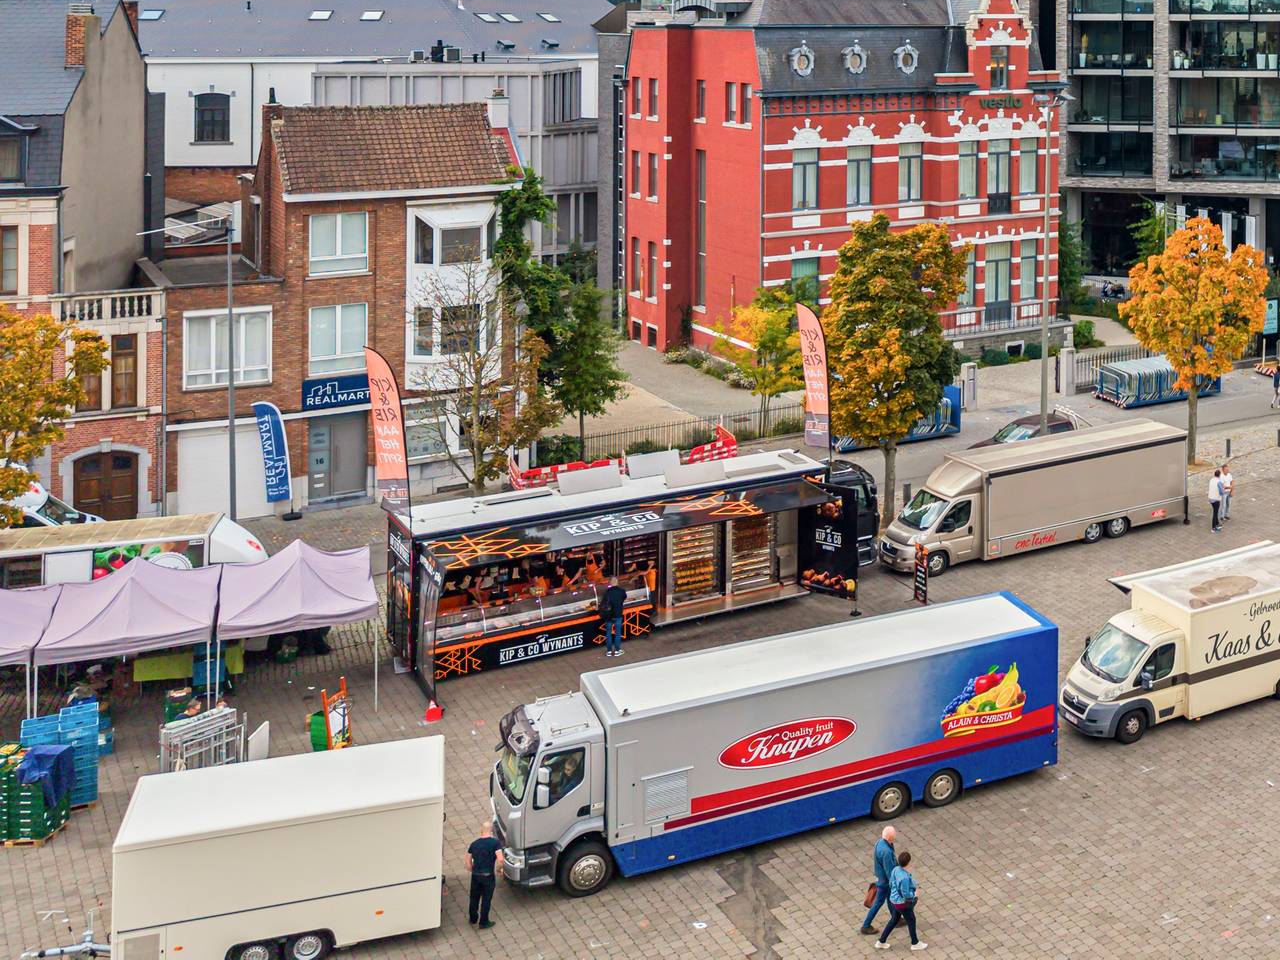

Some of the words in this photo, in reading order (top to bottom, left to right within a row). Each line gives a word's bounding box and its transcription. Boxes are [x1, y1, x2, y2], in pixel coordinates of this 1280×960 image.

[306, 390, 371, 406] REALMART
[566, 522, 600, 535] KIP
[609, 519, 628, 527] &
[632, 512, 660, 523] CO
[600, 524, 645, 536] WYNANTS
[815, 531, 825, 541] KIP
[827, 533, 832, 543] &
[833, 534, 842, 544] CO
[500, 650, 515, 662] KIP
[517, 648, 525, 658] &
[528, 644, 539, 655] CO
[542, 635, 583, 652] WYNANTS
[1205, 630, 1251, 664] Kaas
[1255, 619, 1274, 651] &
[947, 717, 972, 730] ALAIN
[973, 716, 980, 725] &
[980, 711, 1013, 724] CHRISTA
[781, 726, 814, 741] Quality
[815, 721, 834, 732] fruit
[740, 730, 834, 764] Knapen
